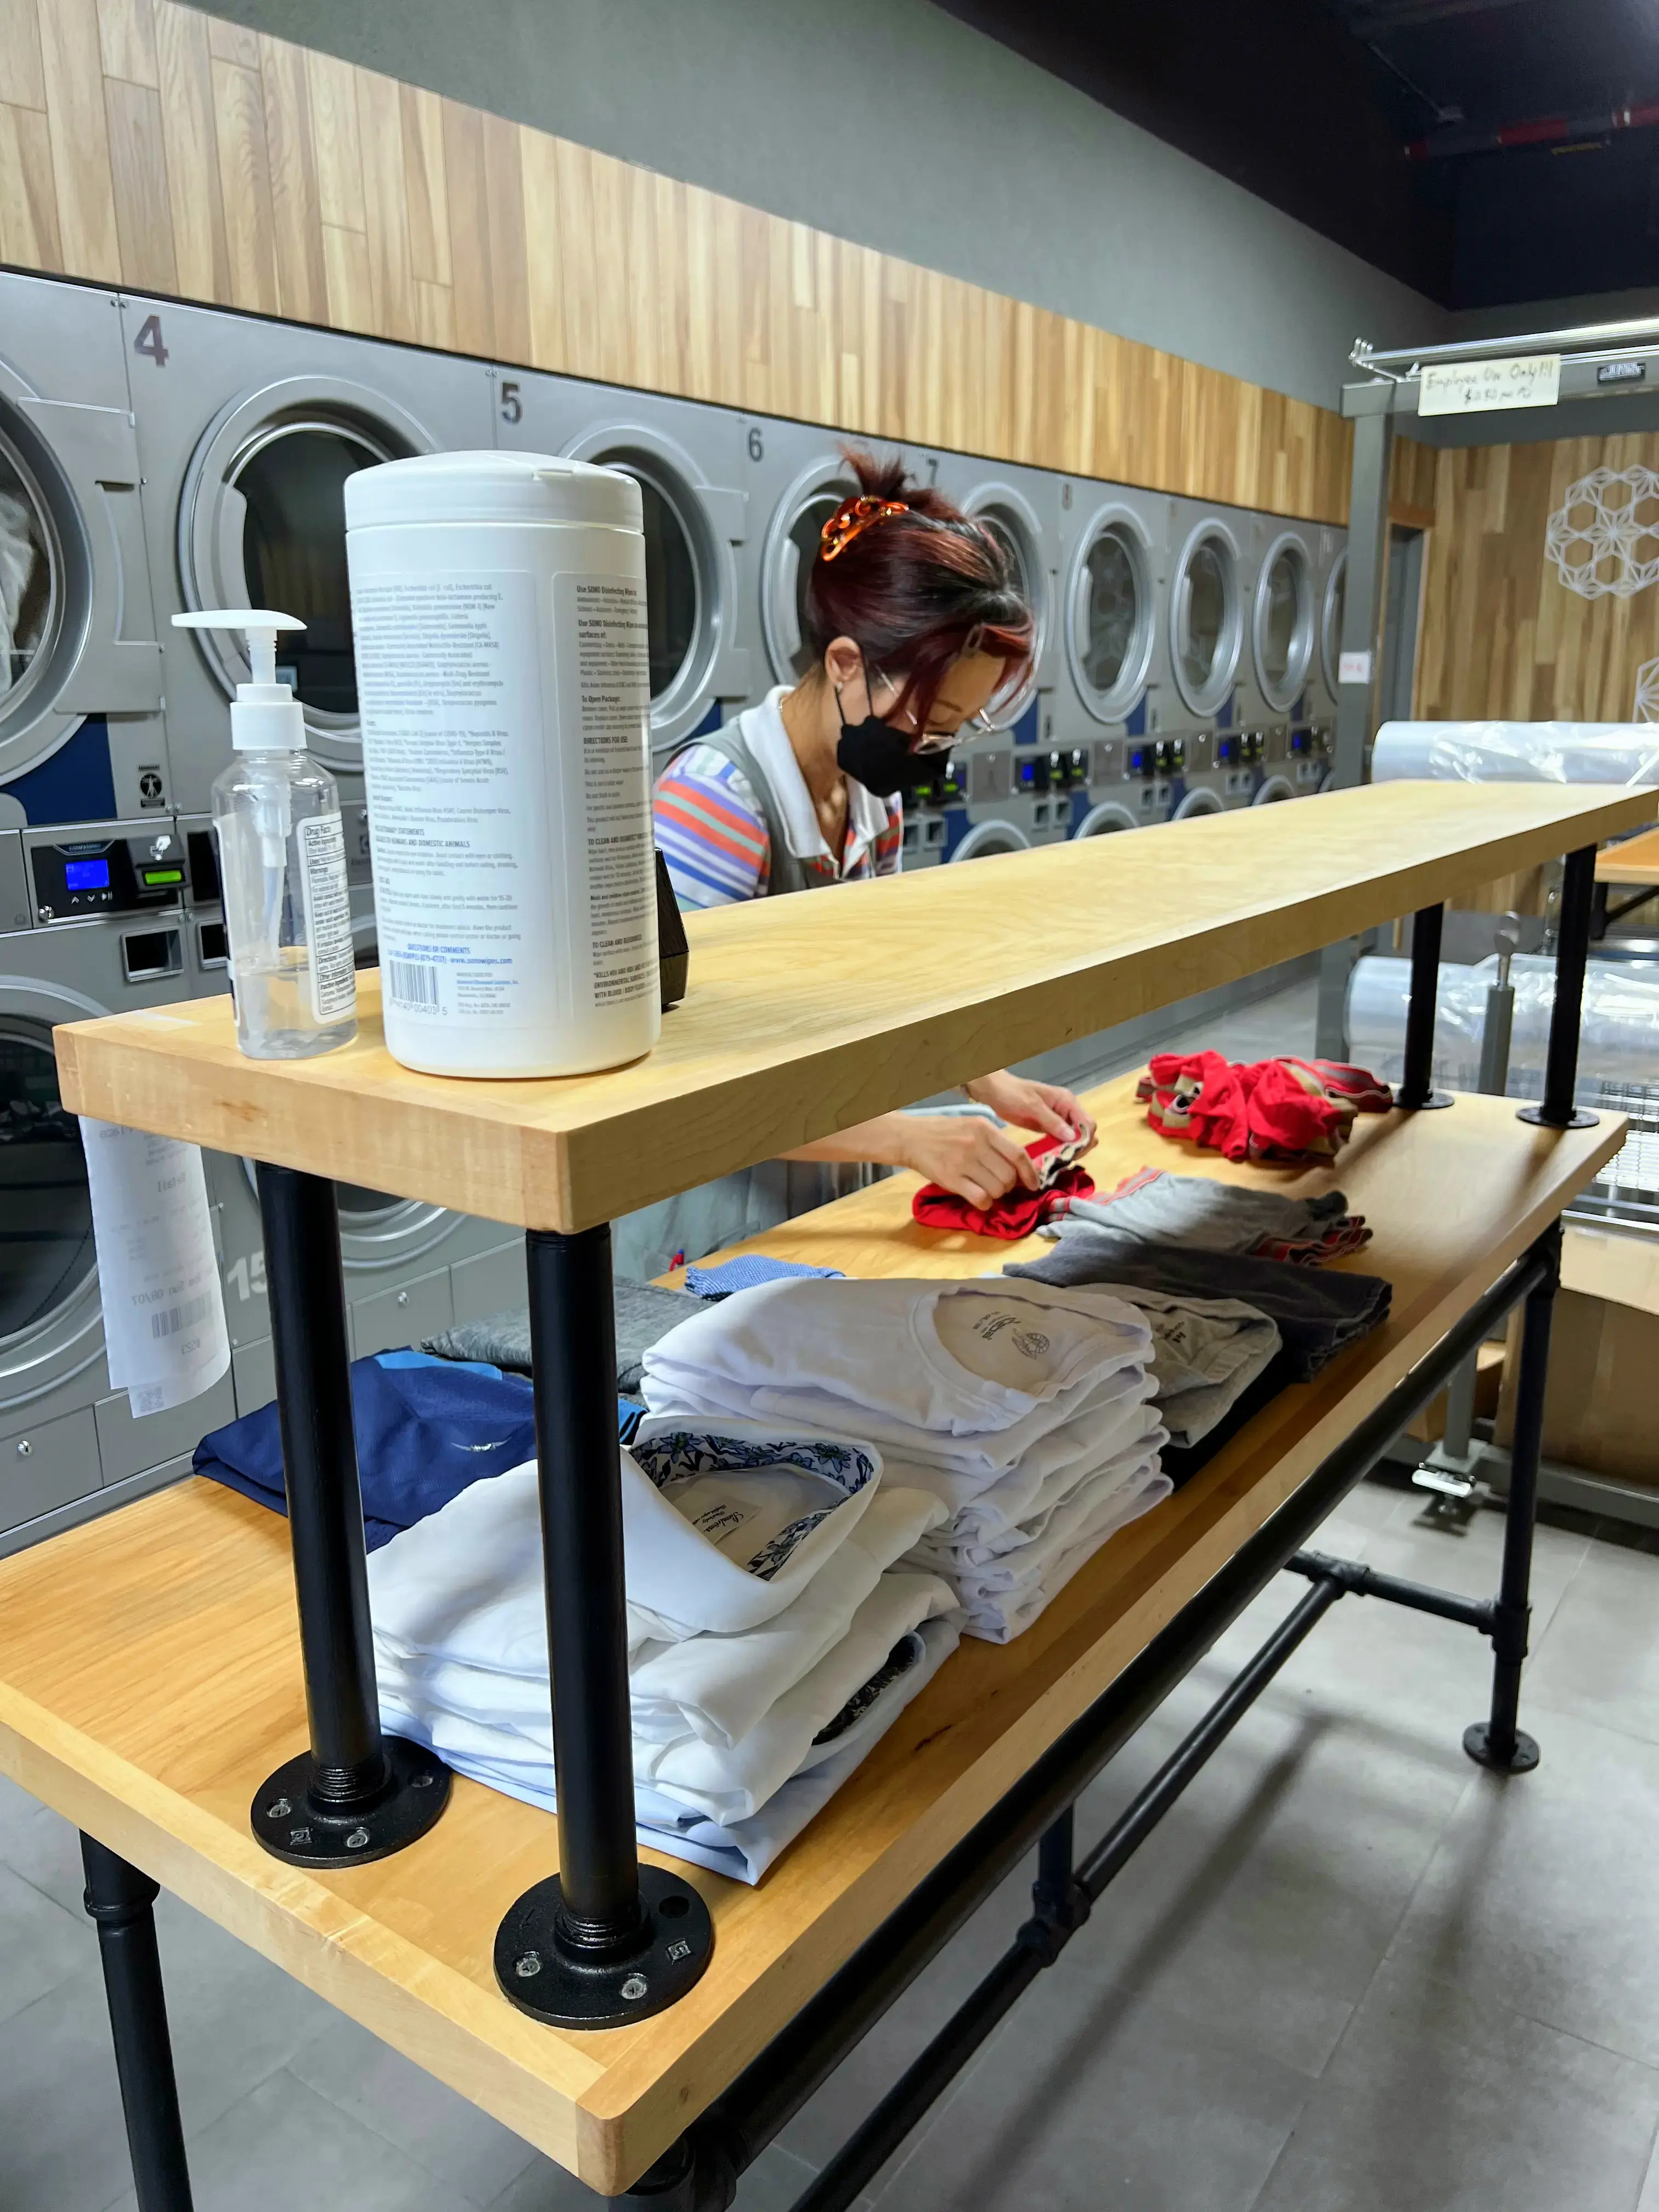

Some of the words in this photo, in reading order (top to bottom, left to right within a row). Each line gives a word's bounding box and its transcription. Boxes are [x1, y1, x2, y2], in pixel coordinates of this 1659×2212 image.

[133, 314, 169, 368] 4
[499, 382, 523, 425] 5
[748, 427, 764, 462] 6
[927, 458, 940, 486] 7
[577, 585, 587, 593] Use
[583, 736, 612, 744] DIRECTIONS
[307, 826, 320, 838] Drug
[418, 839, 444, 848] DOMESTIC
[445, 840, 471, 848] ANIMALS
[595, 837, 610, 845] CLEAN
[310, 866, 329, 874] Warnings
[440, 946, 471, 955] COMMENTS
